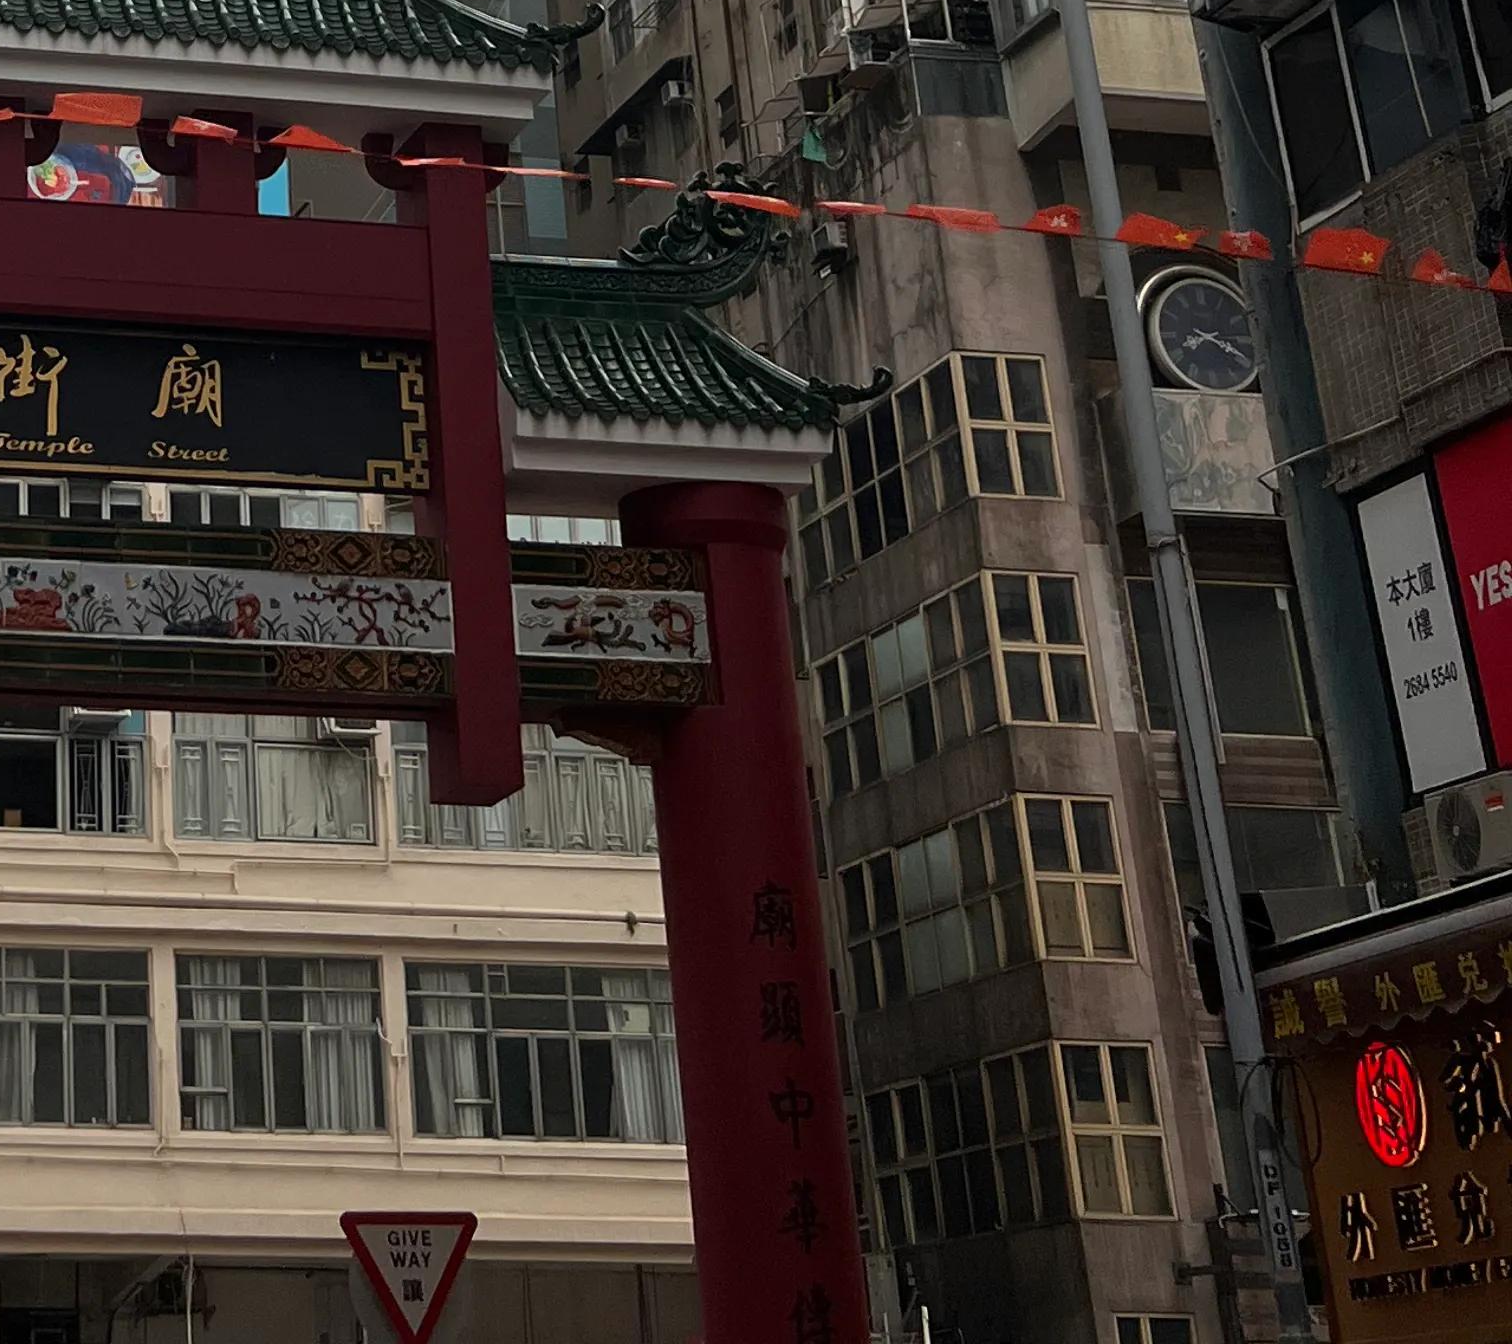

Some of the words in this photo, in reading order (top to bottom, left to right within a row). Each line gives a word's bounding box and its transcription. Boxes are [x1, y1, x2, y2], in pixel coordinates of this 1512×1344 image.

[147, 440, 230, 462] Street
[1387, 562, 1436, 606] 本大廈
[1470, 560, 1512, 611] YES
[1407, 607, 1434, 641] 1樓
[1431, 661, 1458, 689] 5540
[1340, 1171, 1512, 1263] 外匯兌
[388, 1230, 432, 1247] GIVE
[390, 1251, 432, 1268] WAY
